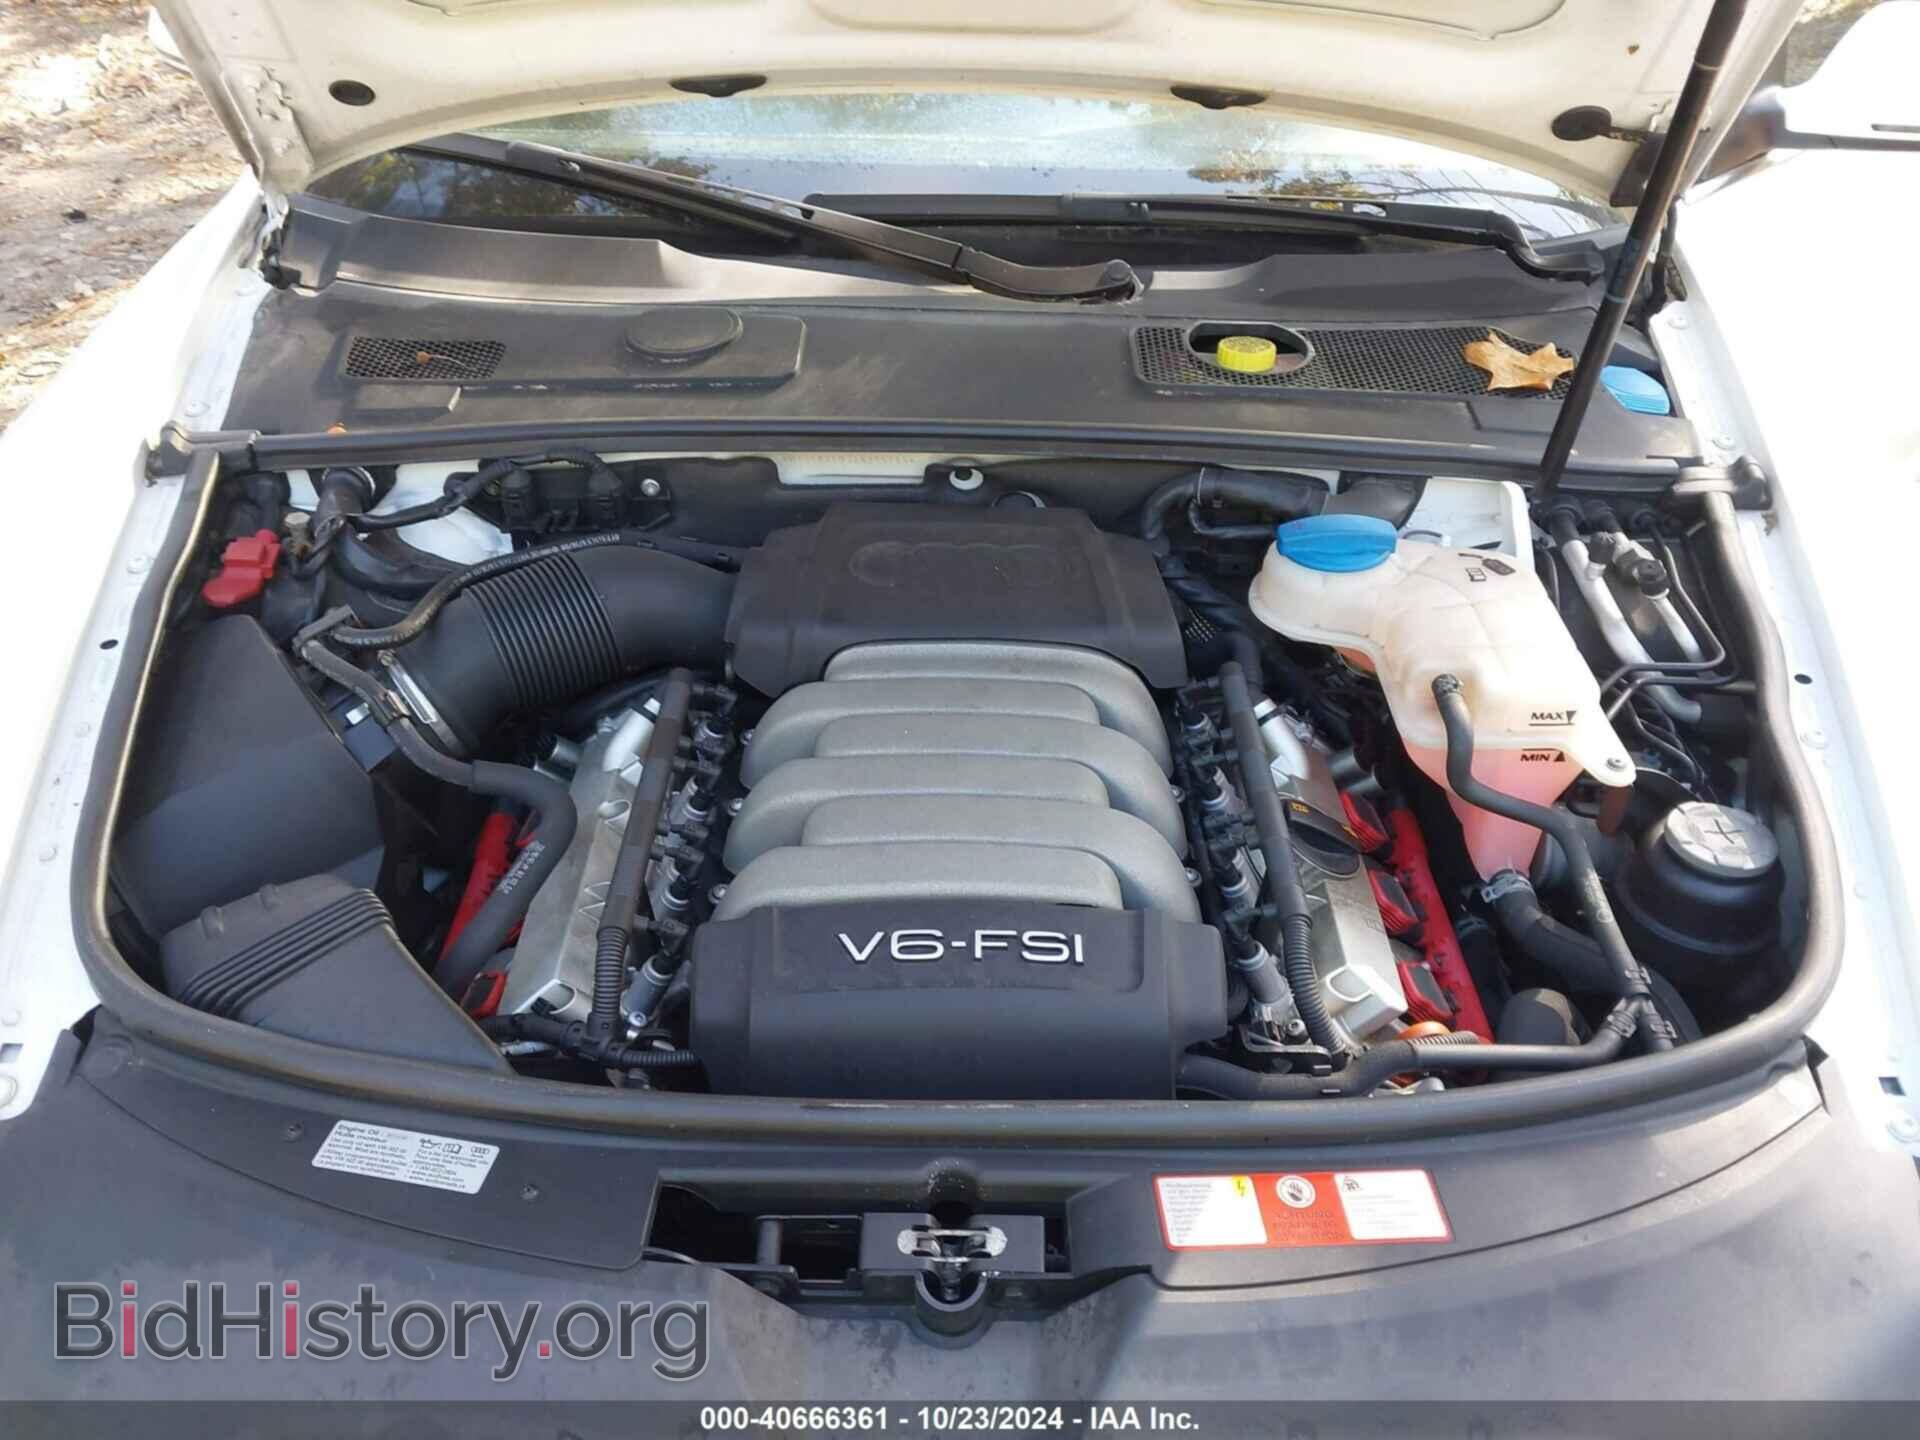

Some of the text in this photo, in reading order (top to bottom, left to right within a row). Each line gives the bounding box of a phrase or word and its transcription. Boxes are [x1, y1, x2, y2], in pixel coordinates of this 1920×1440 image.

[1531, 711, 1563, 720] MAX
[1520, 753, 1550, 762] MIN
[837, 928, 1085, 964] V6-FSI
